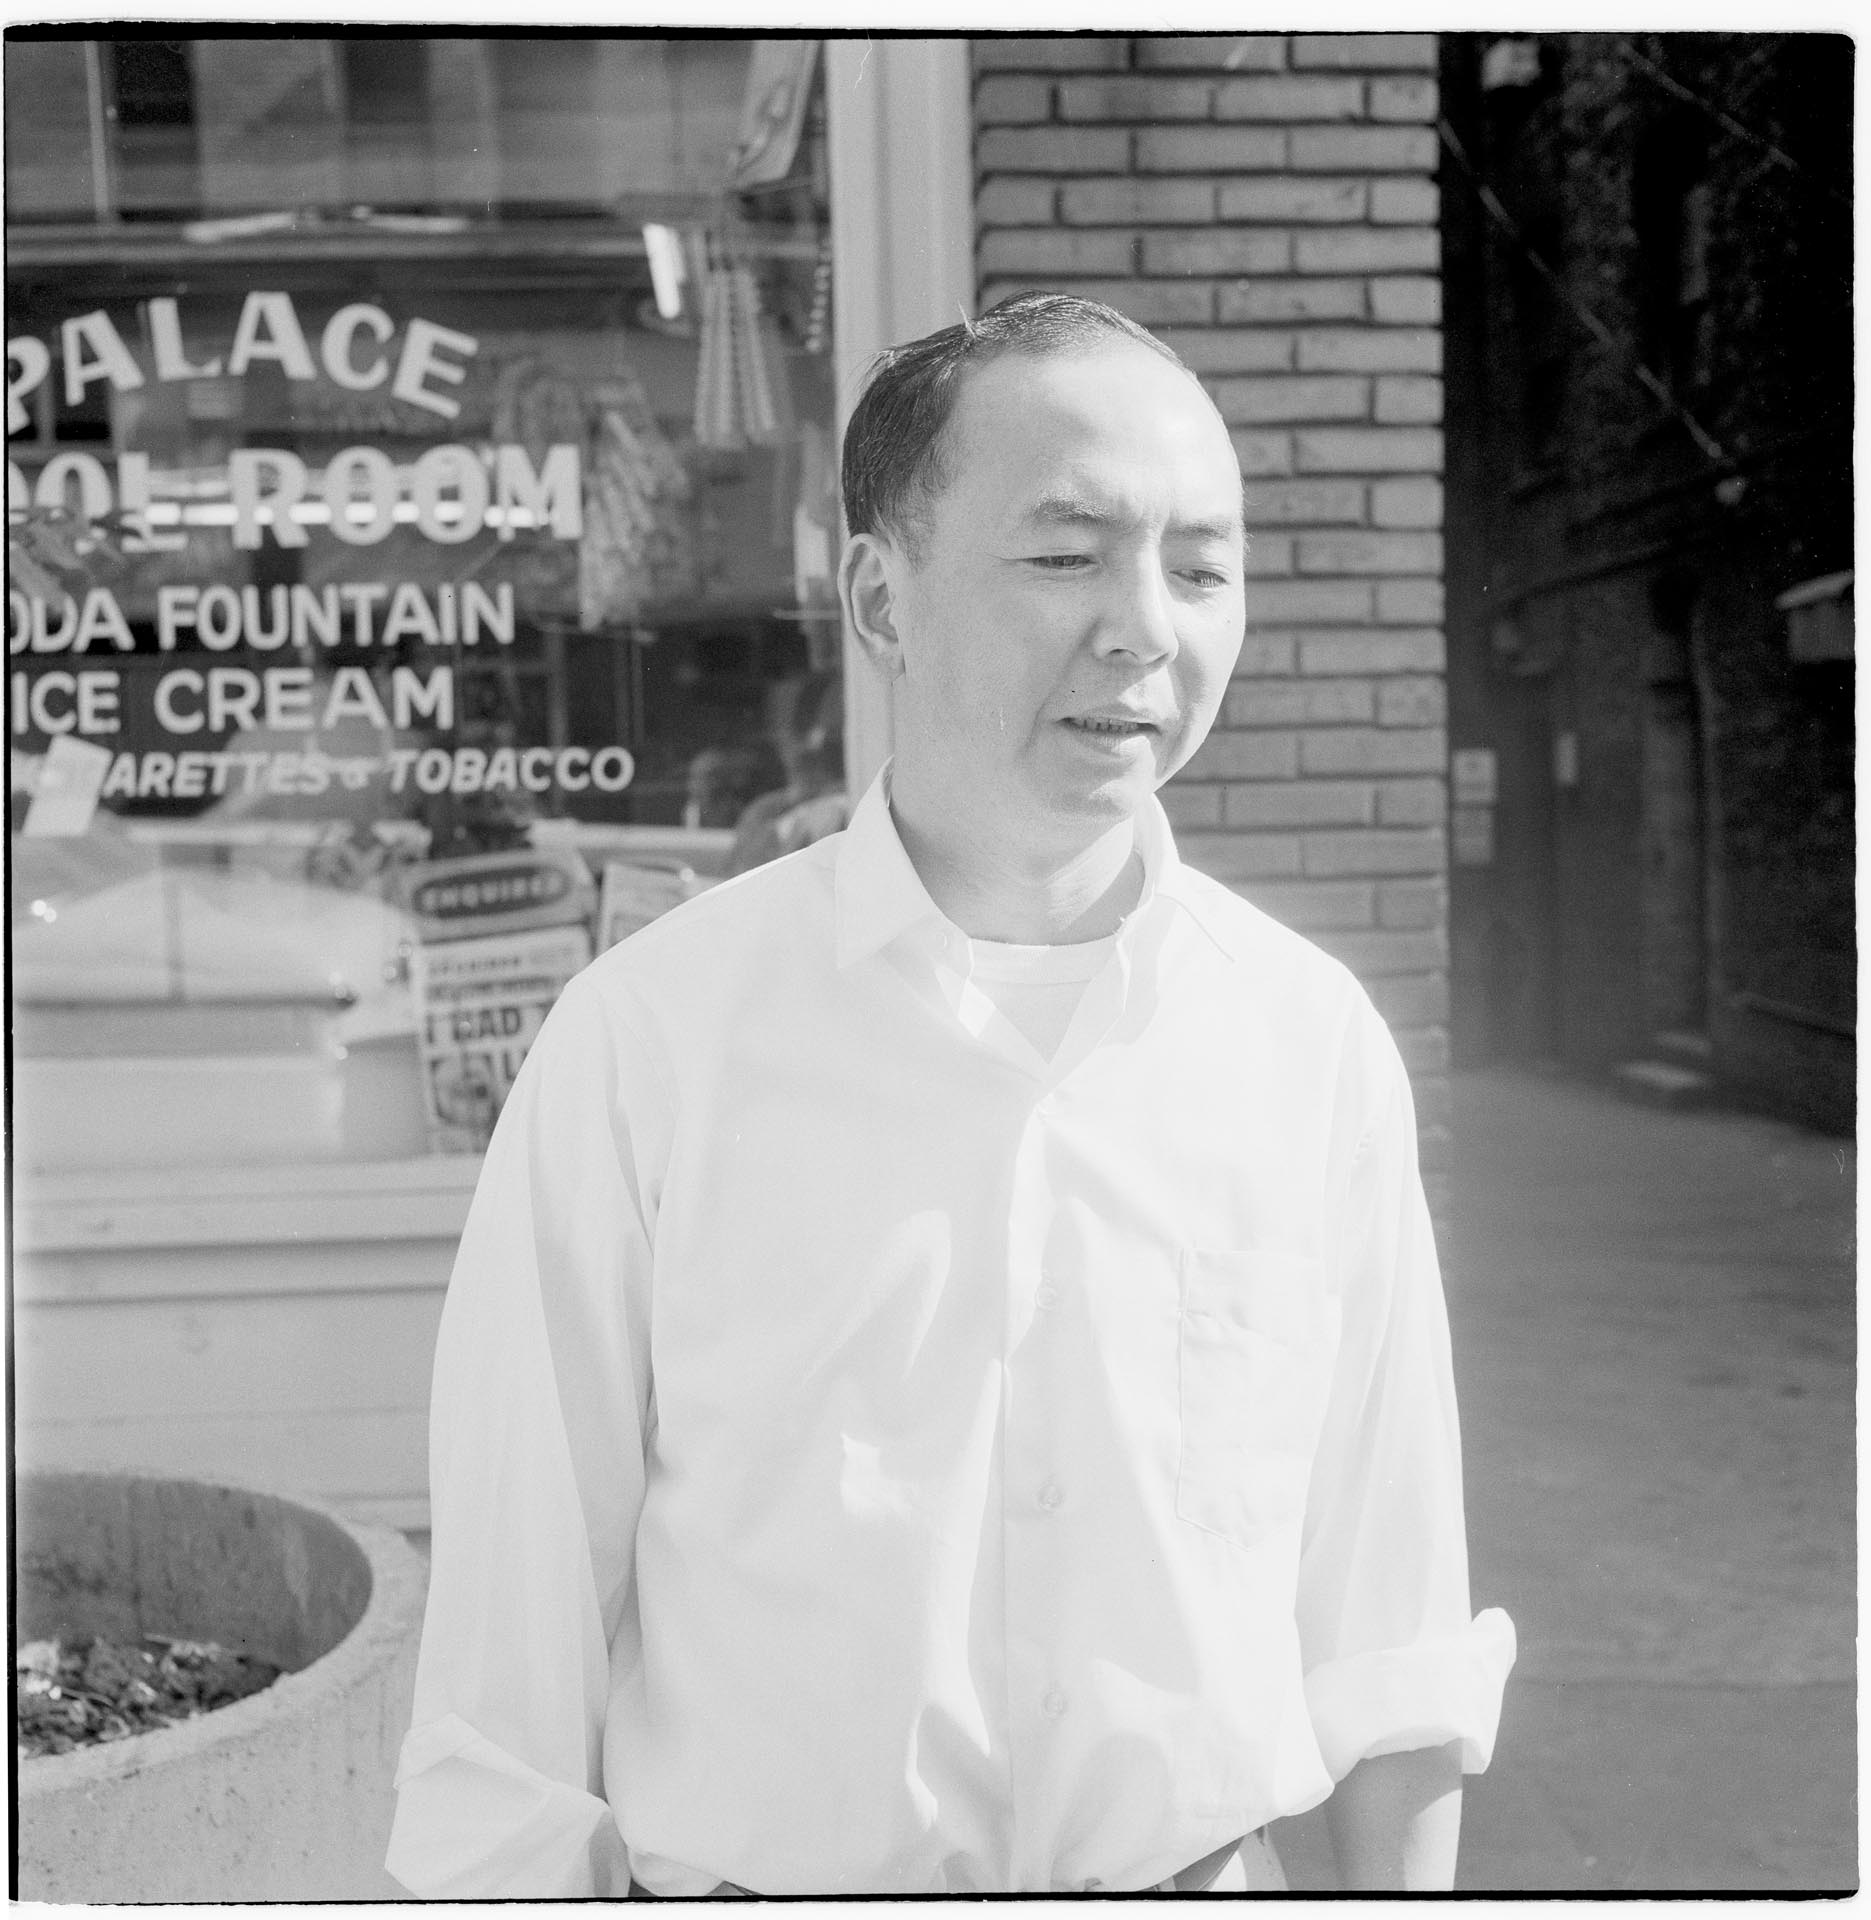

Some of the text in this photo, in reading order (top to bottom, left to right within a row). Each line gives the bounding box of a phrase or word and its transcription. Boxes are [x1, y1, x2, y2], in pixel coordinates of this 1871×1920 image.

[229, 444, 582, 550] ROOM
[157, 581, 516, 652] FOUNTAIN
[11, 666, 455, 735] ICE CREAM
[388, 745, 636, 794] TOBACCO
